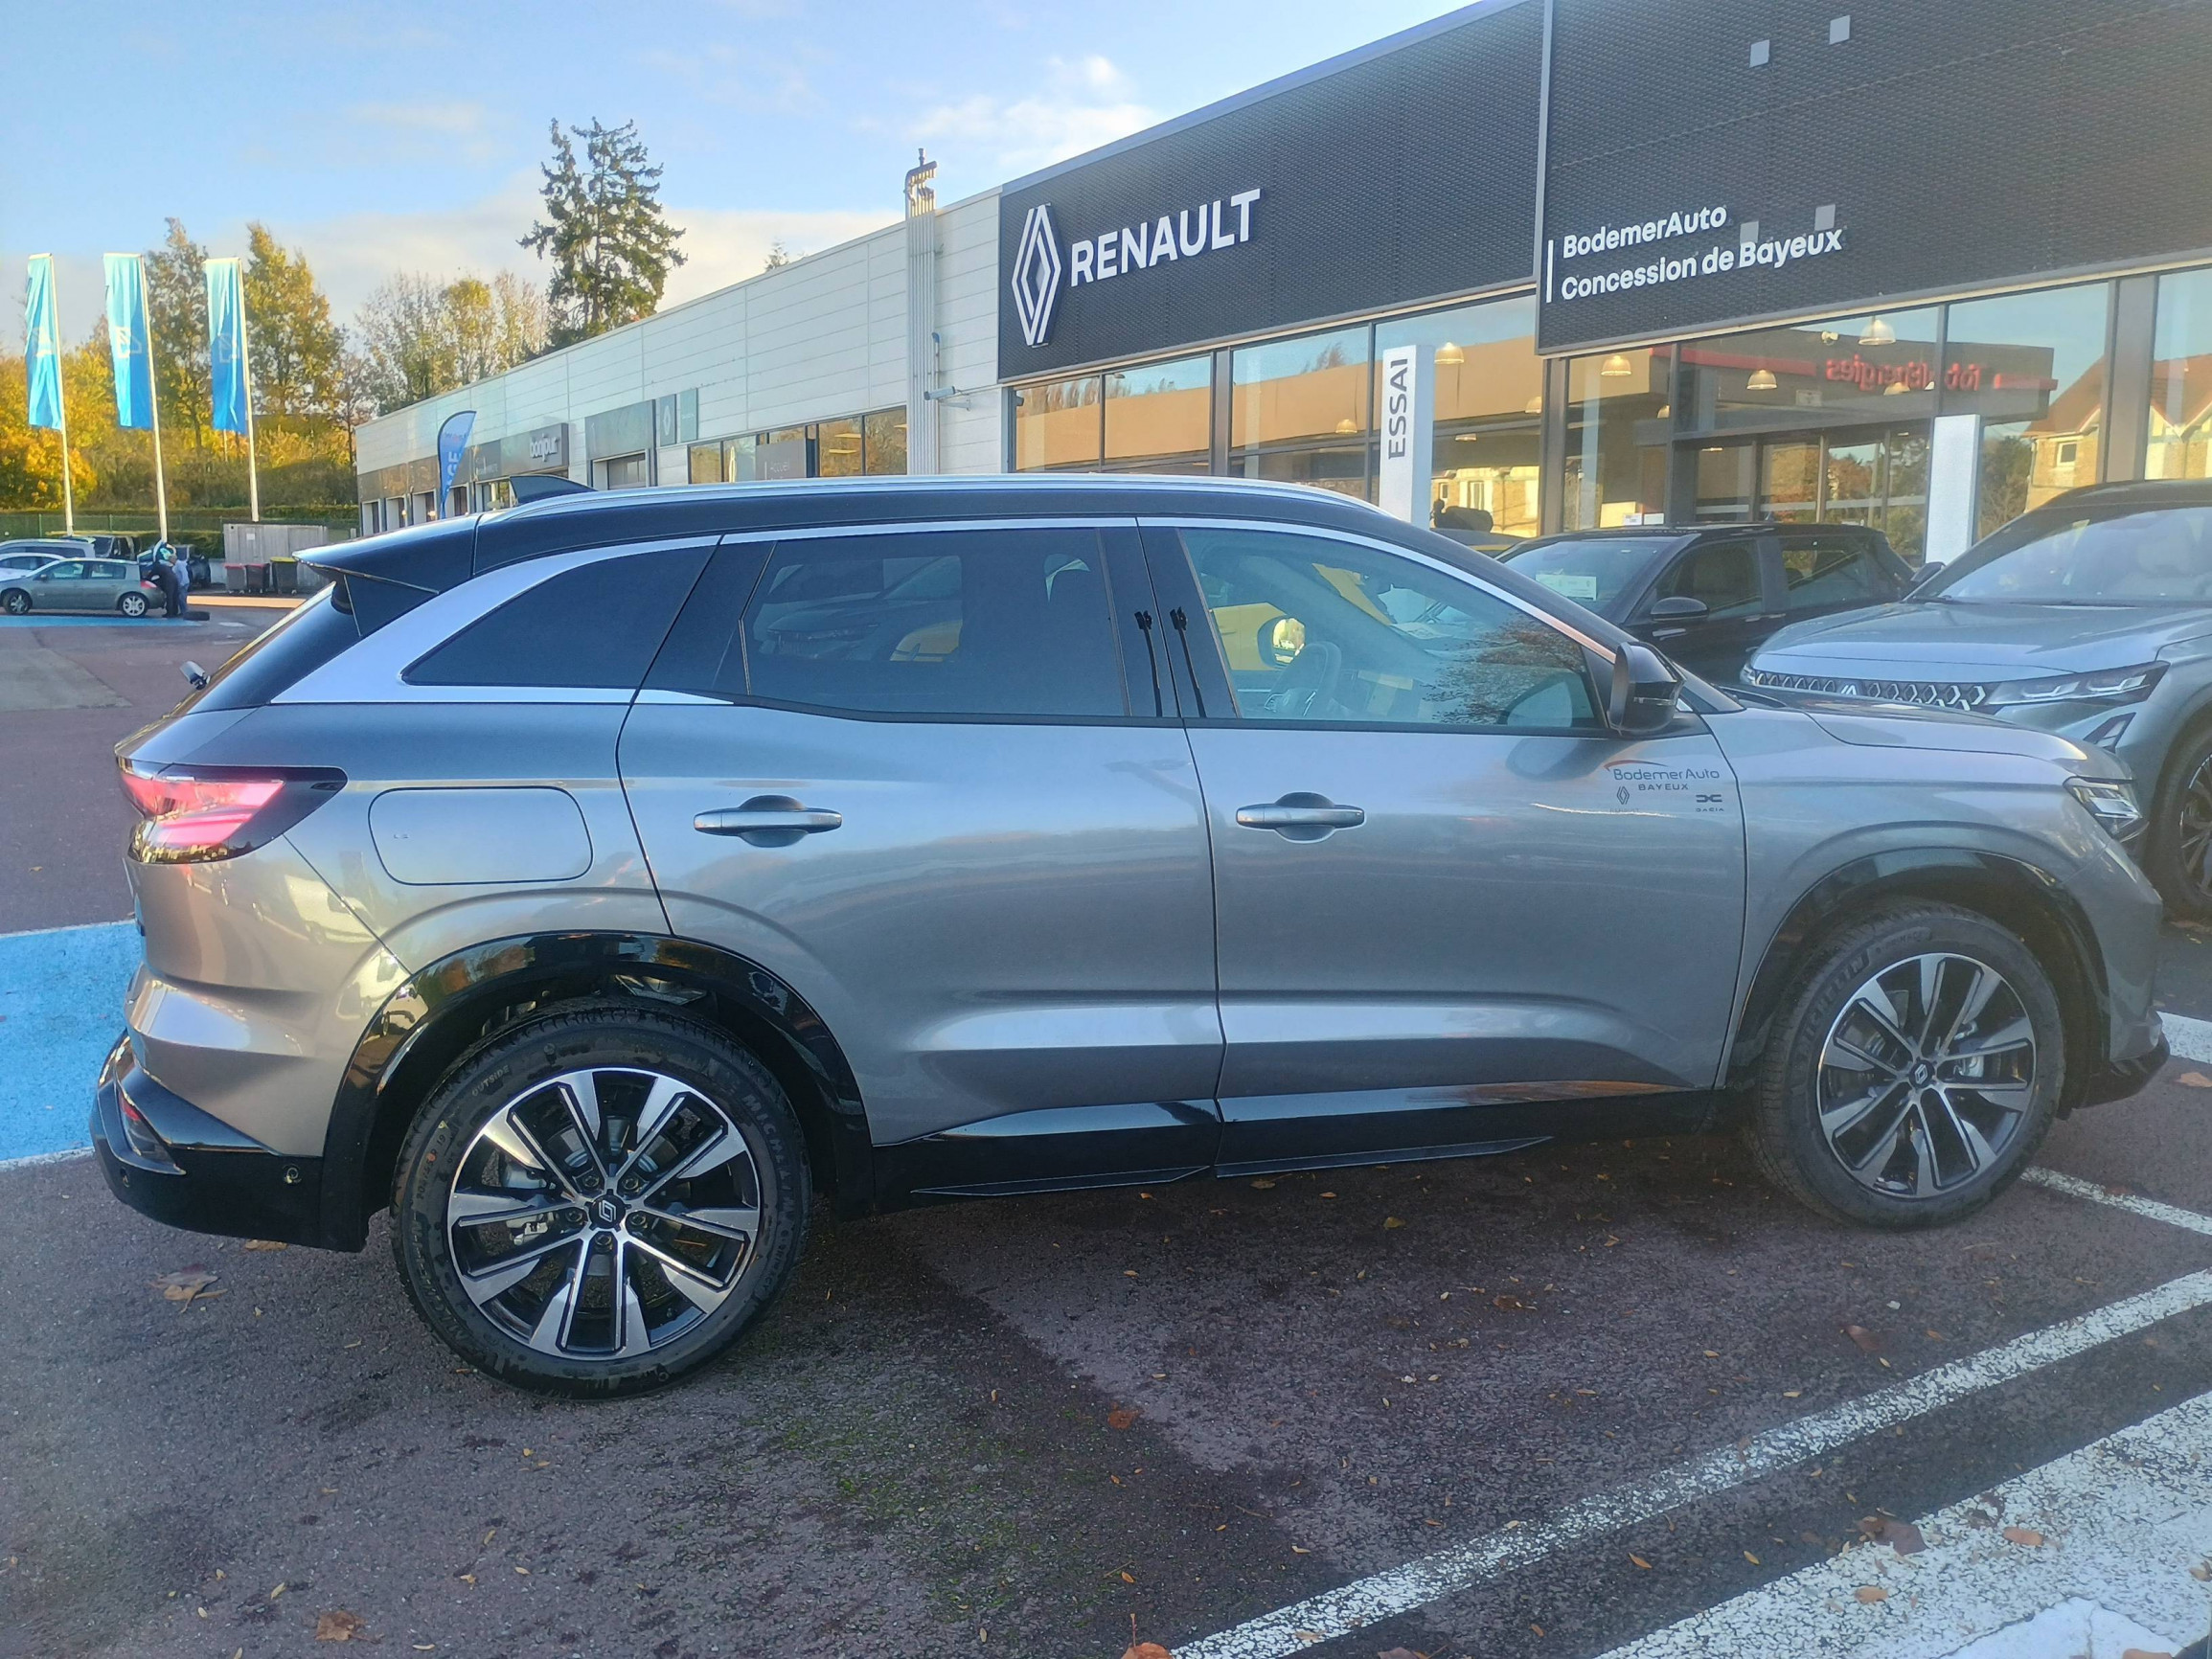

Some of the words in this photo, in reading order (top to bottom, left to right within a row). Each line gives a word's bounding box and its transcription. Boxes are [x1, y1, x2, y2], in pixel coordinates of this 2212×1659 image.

[1071, 188, 1261, 287] RENAULT
[1562, 205, 1727, 259] BodemerAuto
[1562, 256, 1697, 301] Concession
[1701, 246, 1734, 275] de
[1739, 229, 1843, 268] Bayeux
[1388, 358, 1408, 460] ESSAI
[530, 433, 558, 462] bonjour
[1613, 768, 1720, 781] BodemerAuto
[471, 1064, 510, 1097] OUTSIDE
